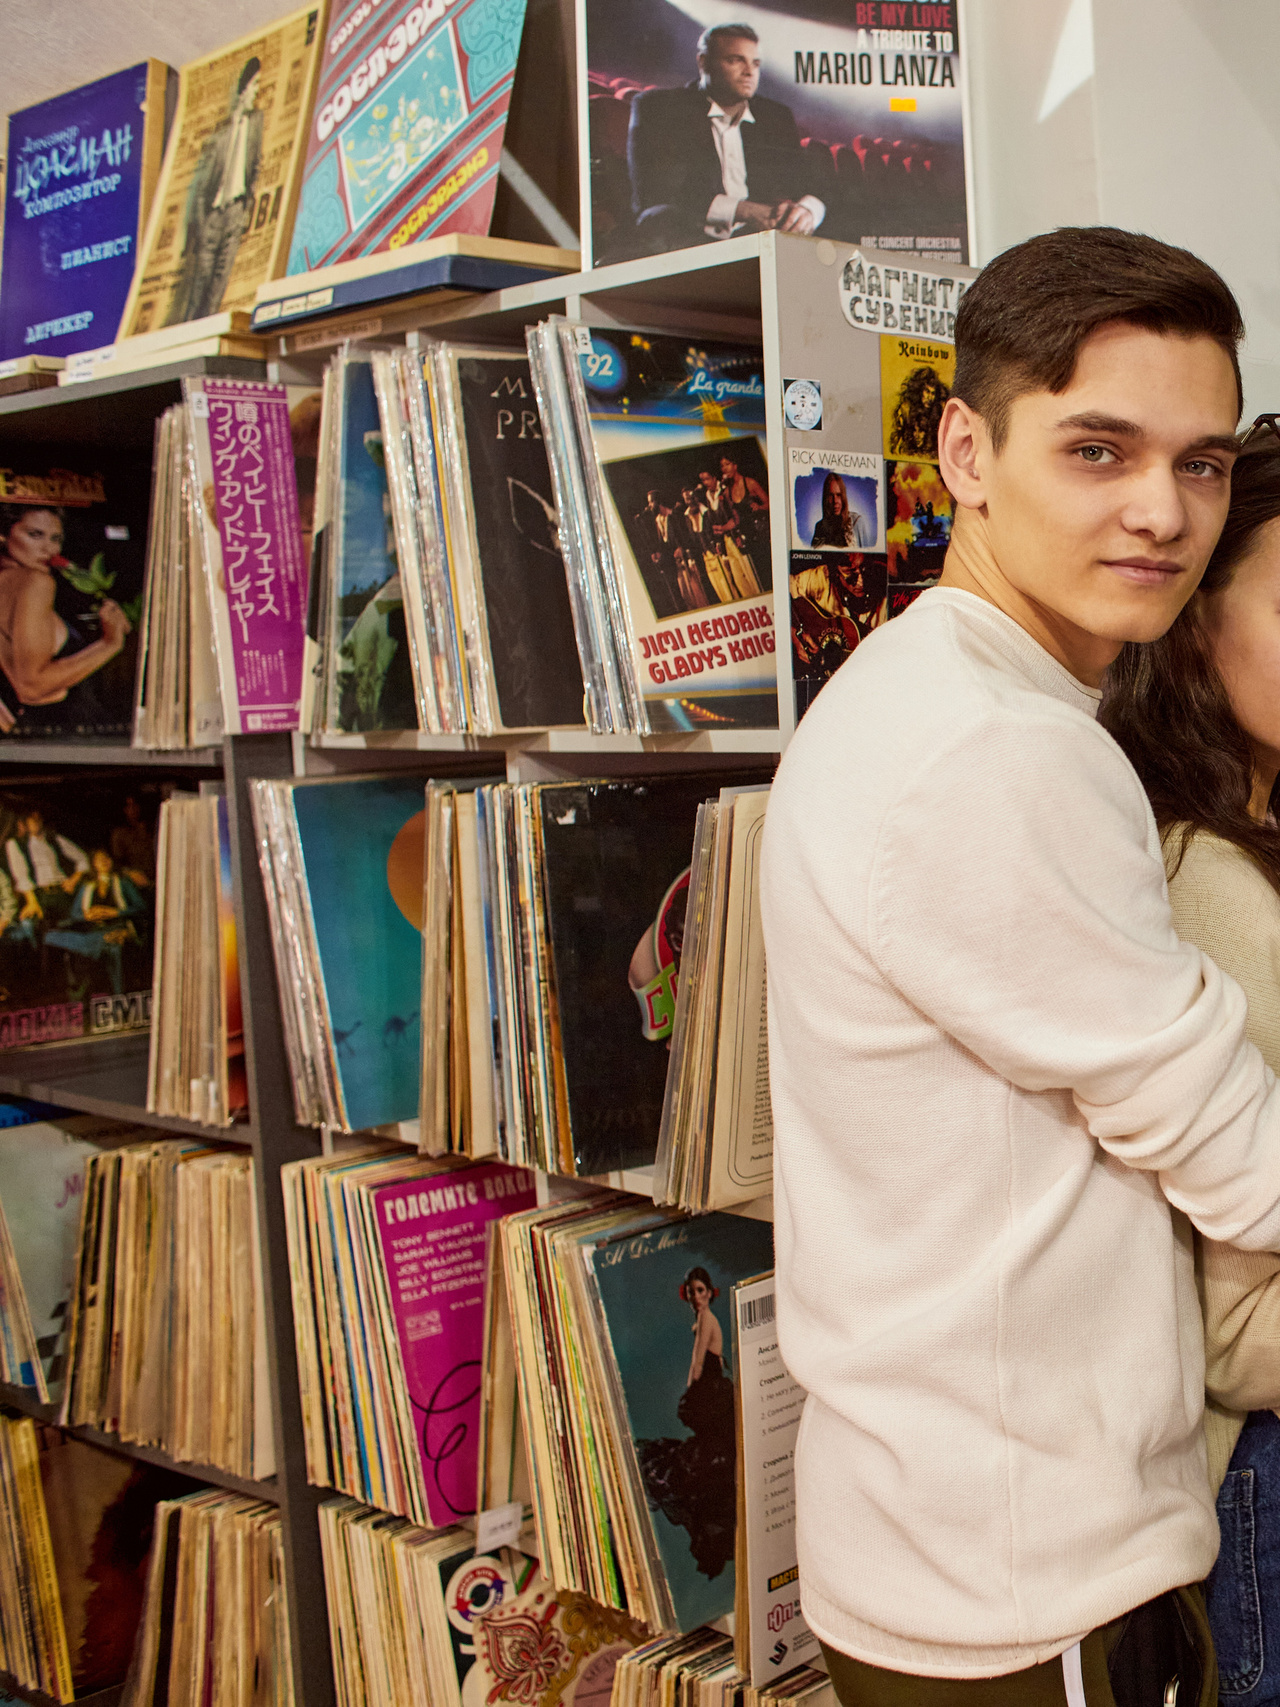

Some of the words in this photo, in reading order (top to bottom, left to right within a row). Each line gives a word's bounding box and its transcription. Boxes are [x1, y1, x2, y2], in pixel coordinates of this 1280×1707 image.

[856, 3, 876, 25] BE
[880, 5, 906, 27] MY
[912, 5, 953, 28] LOVE
[857, 29, 867, 48] A
[871, 30, 931, 52] TRIBUTE
[933, 31, 953, 53] TO
[795, 51, 872, 86] MARIO
[879, 53, 955, 88] LANZA
[61, 235, 132, 270] ПИАНИСТ
[878, 236, 915, 249] CONCERT
[915, 236, 962, 250] ORCHESTRA
[898, 340, 950, 360] Rainbow
[585, 353, 614, 377] 92
[689, 371, 714, 393] La
[715, 379, 764, 399] grande
[792, 450, 816, 465] RICK
[819, 453, 877, 469] WAKEMAN
[638, 627, 687, 659] JIMI
[687, 605, 774, 646] HENDRIX
[648, 645, 728, 684] GLADYS
[383, 1180, 479, 1225] ГОЛЕМИТЕ
[391, 1234, 423, 1250] TONY
[425, 1221, 474, 1242] BENNETT
[393, 1245, 435, 1264] SARAH
[396, 1262, 420, 1277] JOE
[422, 1248, 473, 1270] WILLIAMS
[398, 1274, 429, 1290] BILLY
[401, 1287, 429, 1303] ELLA
